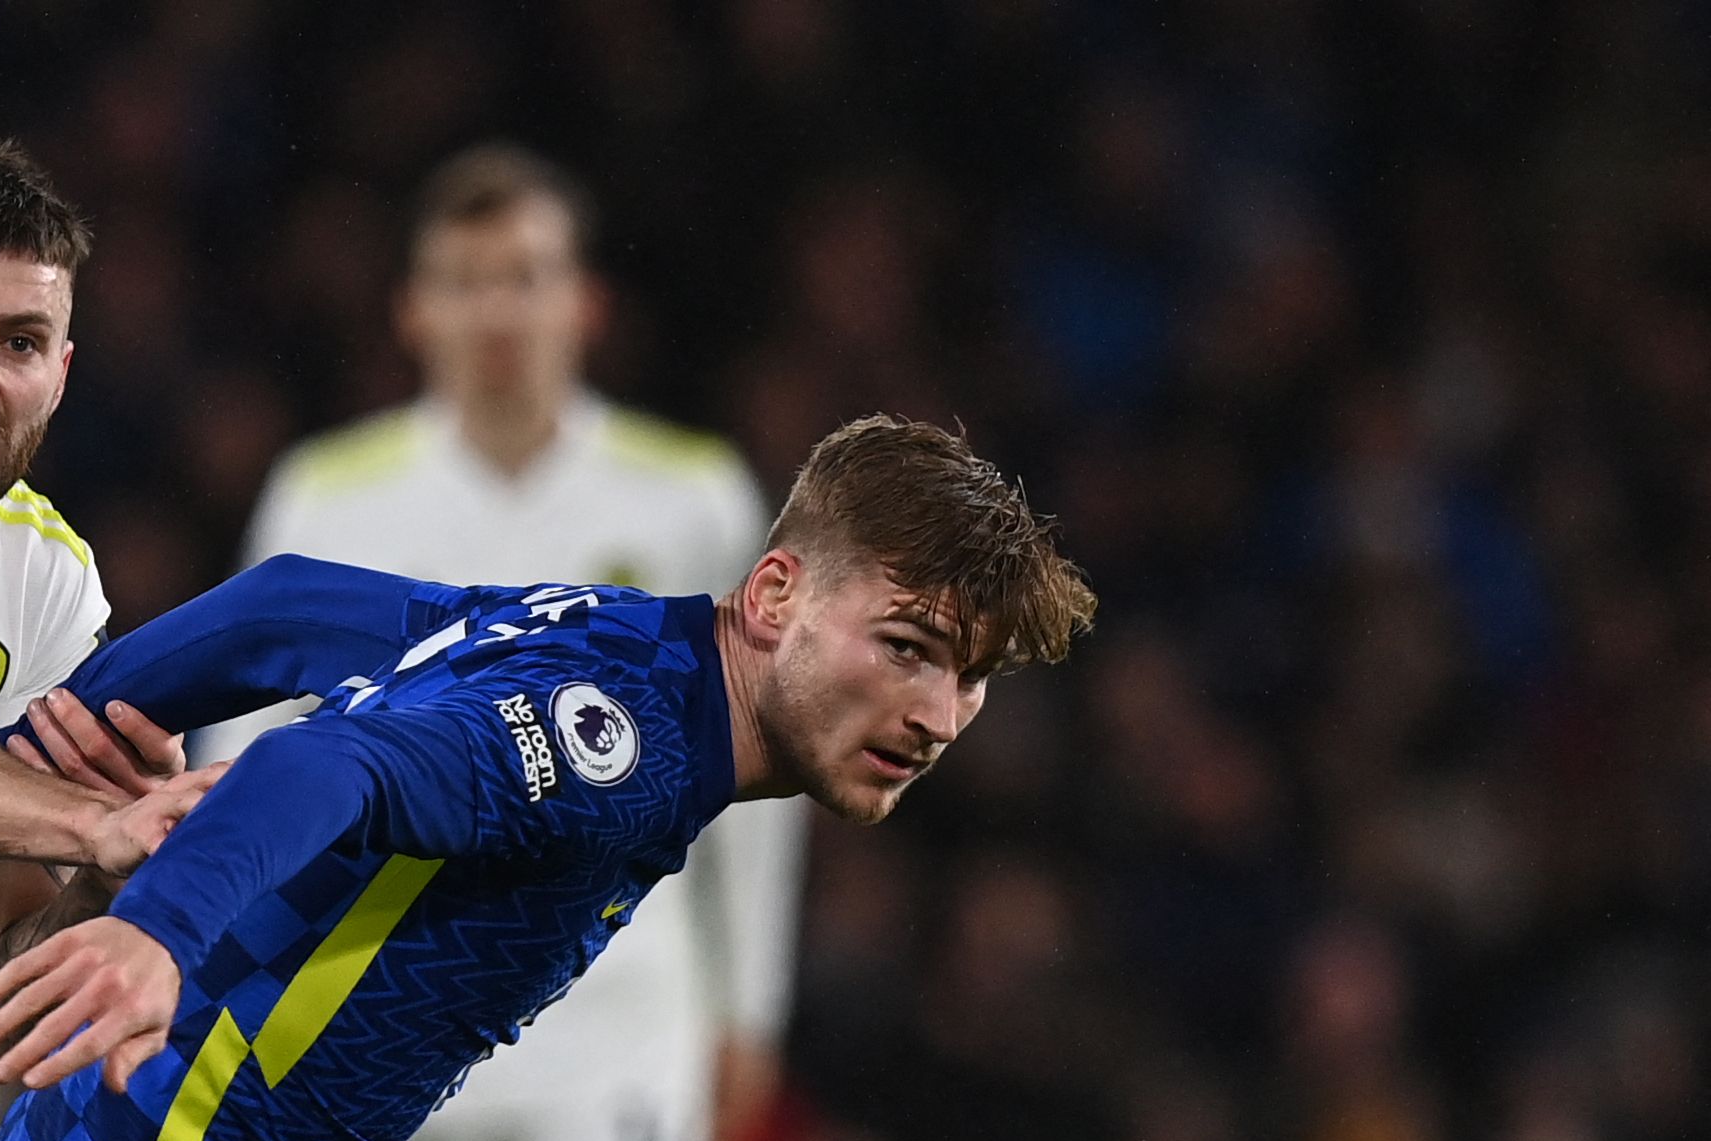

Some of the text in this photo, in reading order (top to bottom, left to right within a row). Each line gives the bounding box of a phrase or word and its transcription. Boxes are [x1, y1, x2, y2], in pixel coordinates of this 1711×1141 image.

[492, 699, 541, 802] for racism
[506, 693, 557, 788] No room
[587, 759, 613, 774] League
